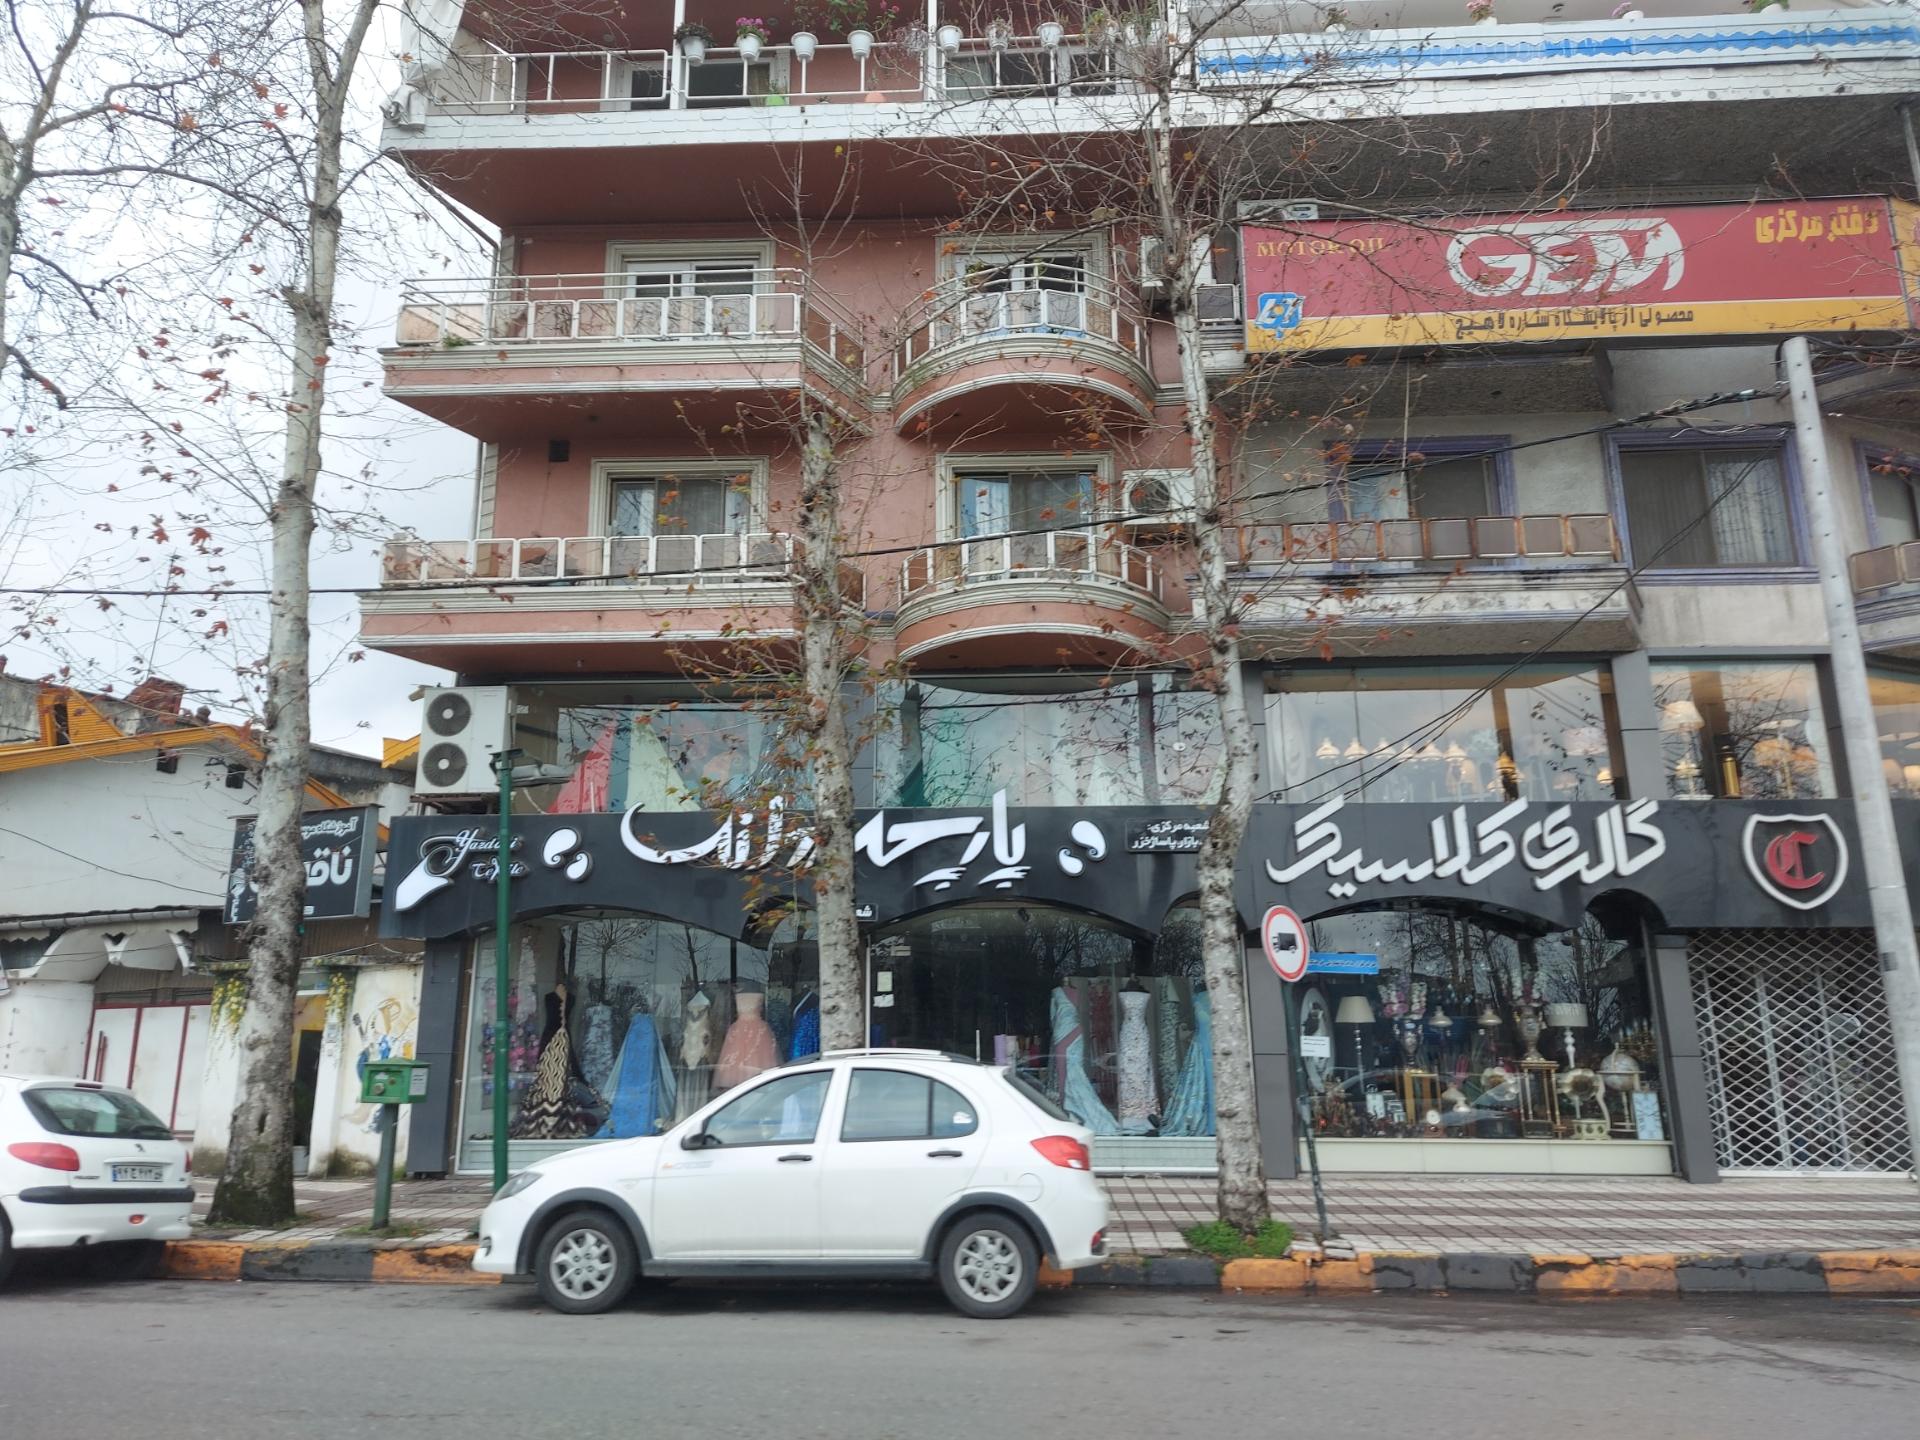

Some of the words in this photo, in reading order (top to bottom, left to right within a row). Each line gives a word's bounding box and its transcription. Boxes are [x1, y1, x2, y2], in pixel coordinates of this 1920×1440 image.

[1446, 217, 1685, 297] GEM
[1755, 208, 1824, 244] مرکزی
[1826, 204, 1879, 242] دفتر
[1621, 307, 1635, 327] از
[855, 788, 1032, 891] پارچه
[1266, 792, 1530, 899] کلاسیک
[1522, 796, 1667, 892] گالری
